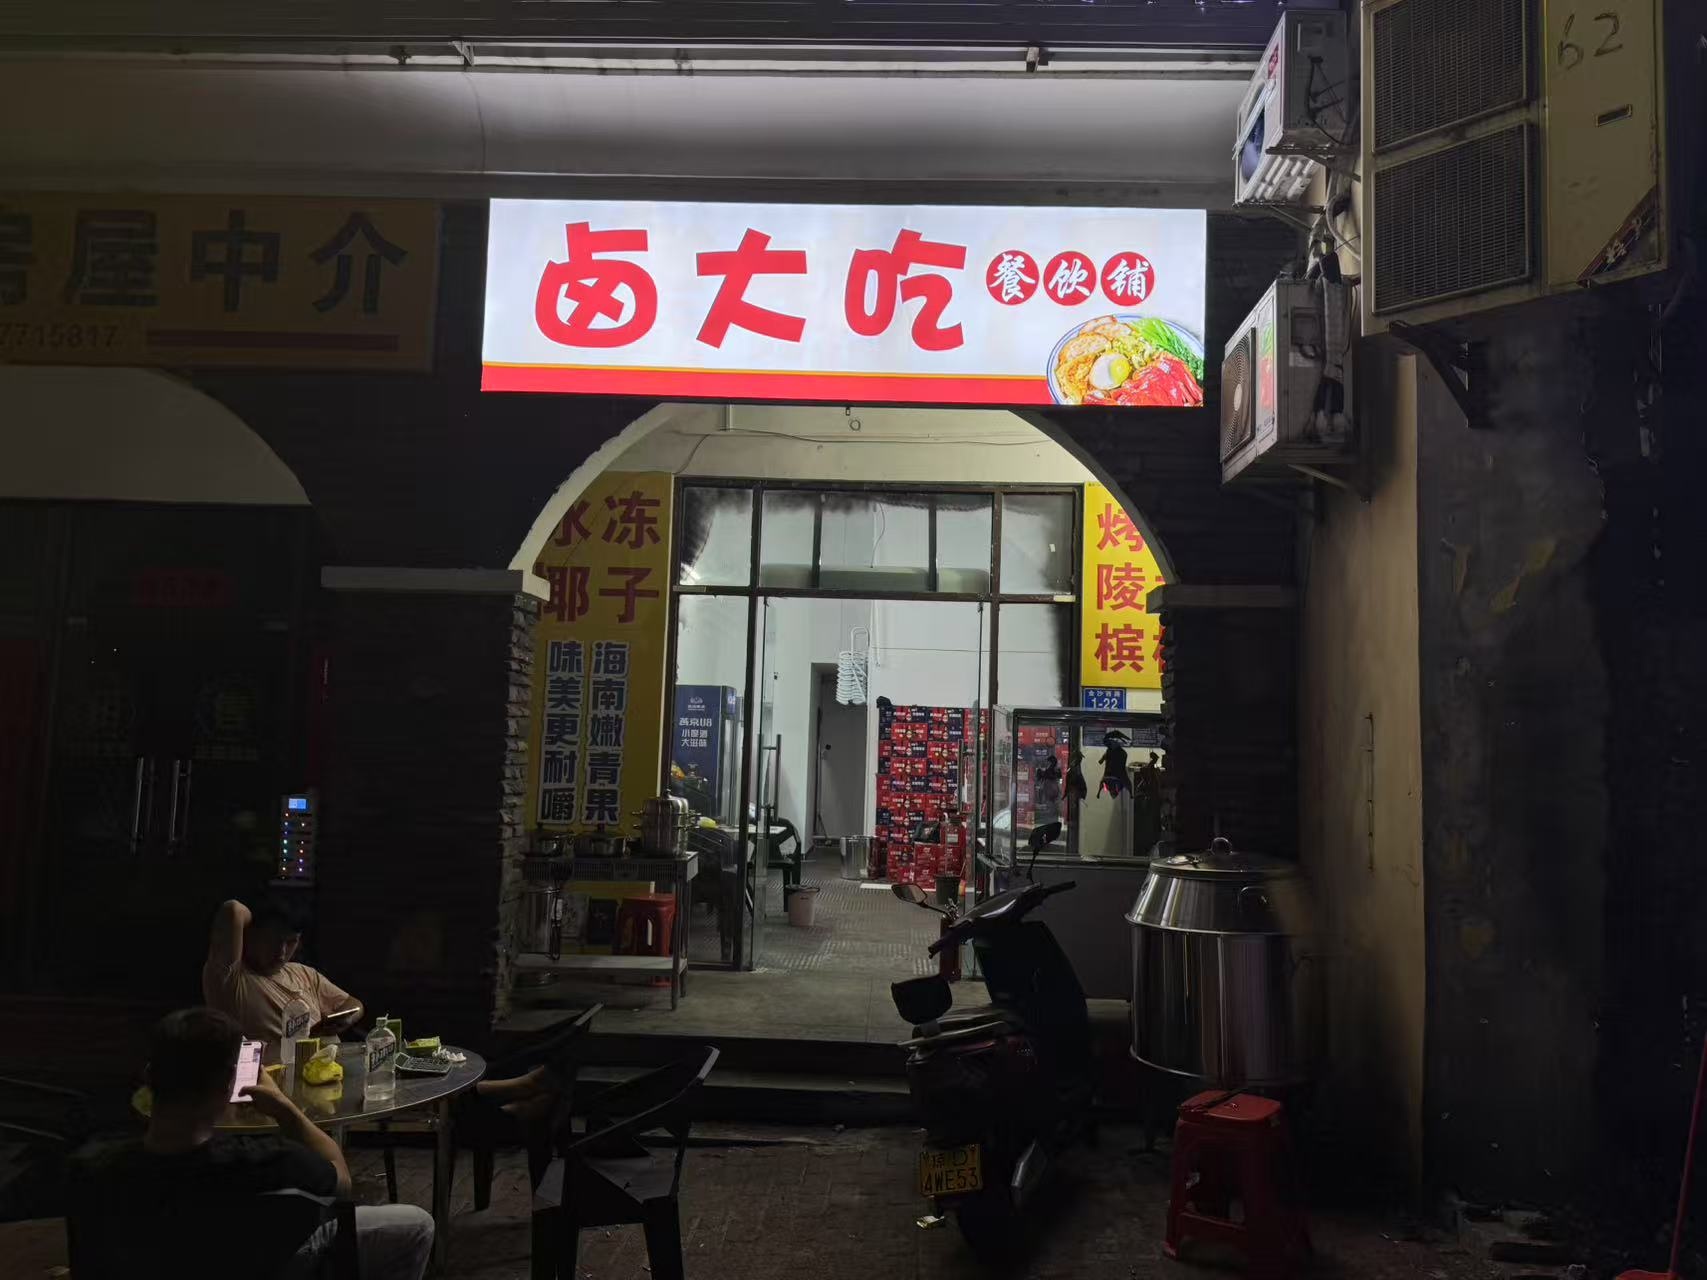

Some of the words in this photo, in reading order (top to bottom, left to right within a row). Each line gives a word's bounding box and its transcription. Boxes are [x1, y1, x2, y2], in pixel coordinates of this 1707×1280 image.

[1558, 13, 1623, 70] 62
[535, 221, 967, 351] 卤大吃
[1096, 562, 1166, 611] 陵
[539, 640, 583, 824] 味美更耐嚼
[582, 641, 628, 825] 海南嫩青果
